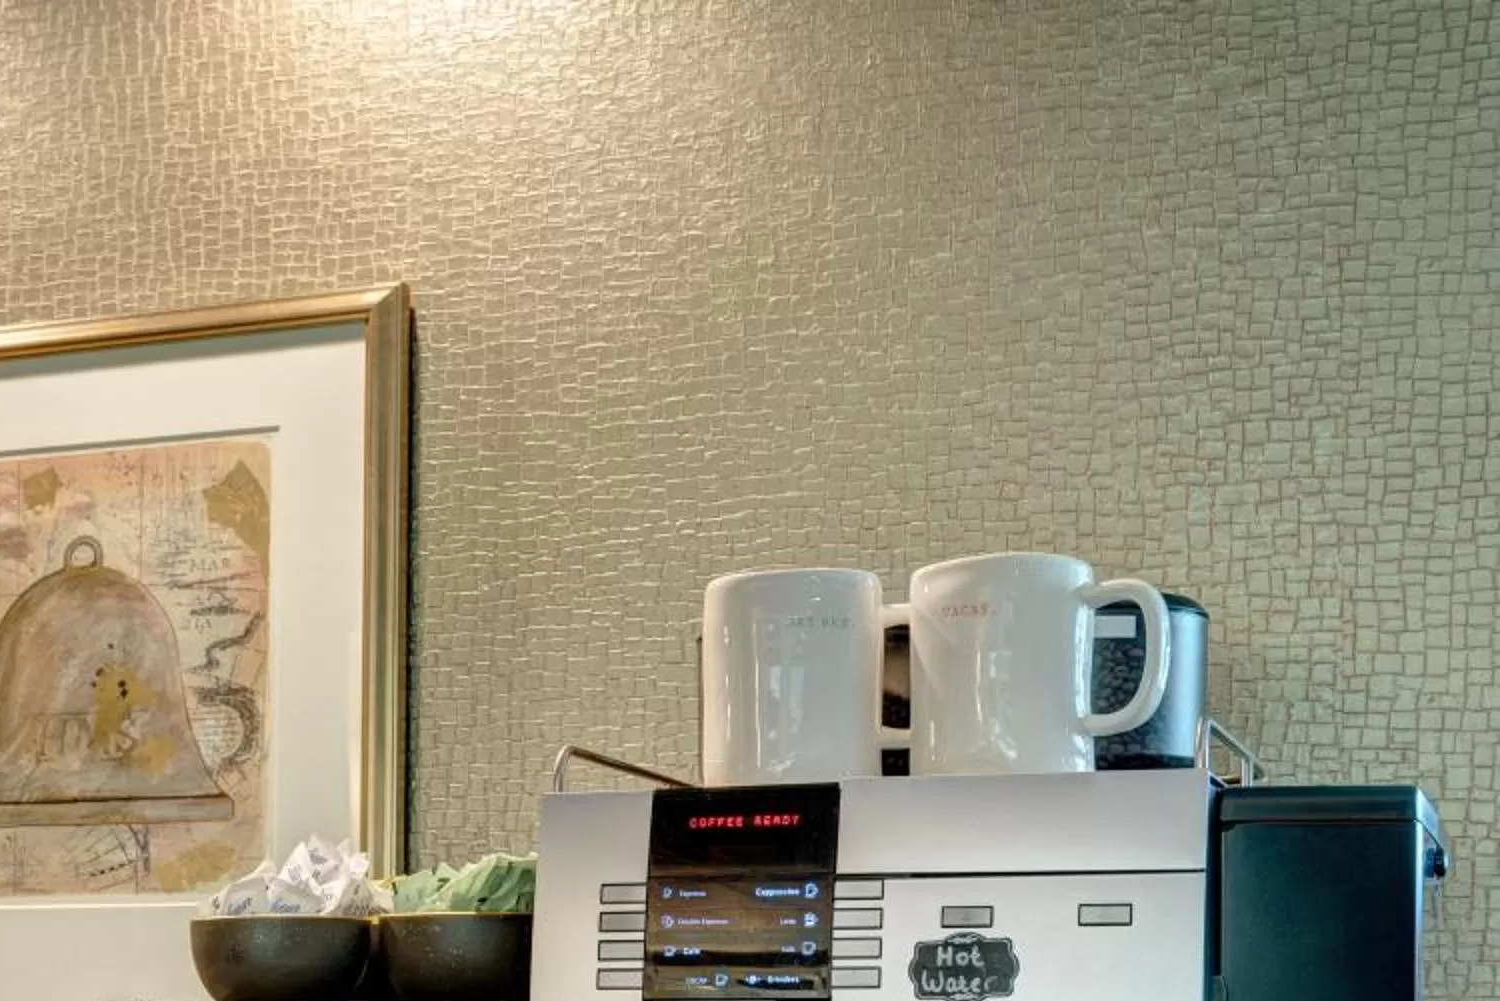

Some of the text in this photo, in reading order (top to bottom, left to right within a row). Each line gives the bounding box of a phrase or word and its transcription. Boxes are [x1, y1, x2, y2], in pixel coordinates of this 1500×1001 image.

[689, 814, 800, 829] COFFEE READY
[936, 944, 985, 967] Hot
[921, 969, 999, 992] Water
